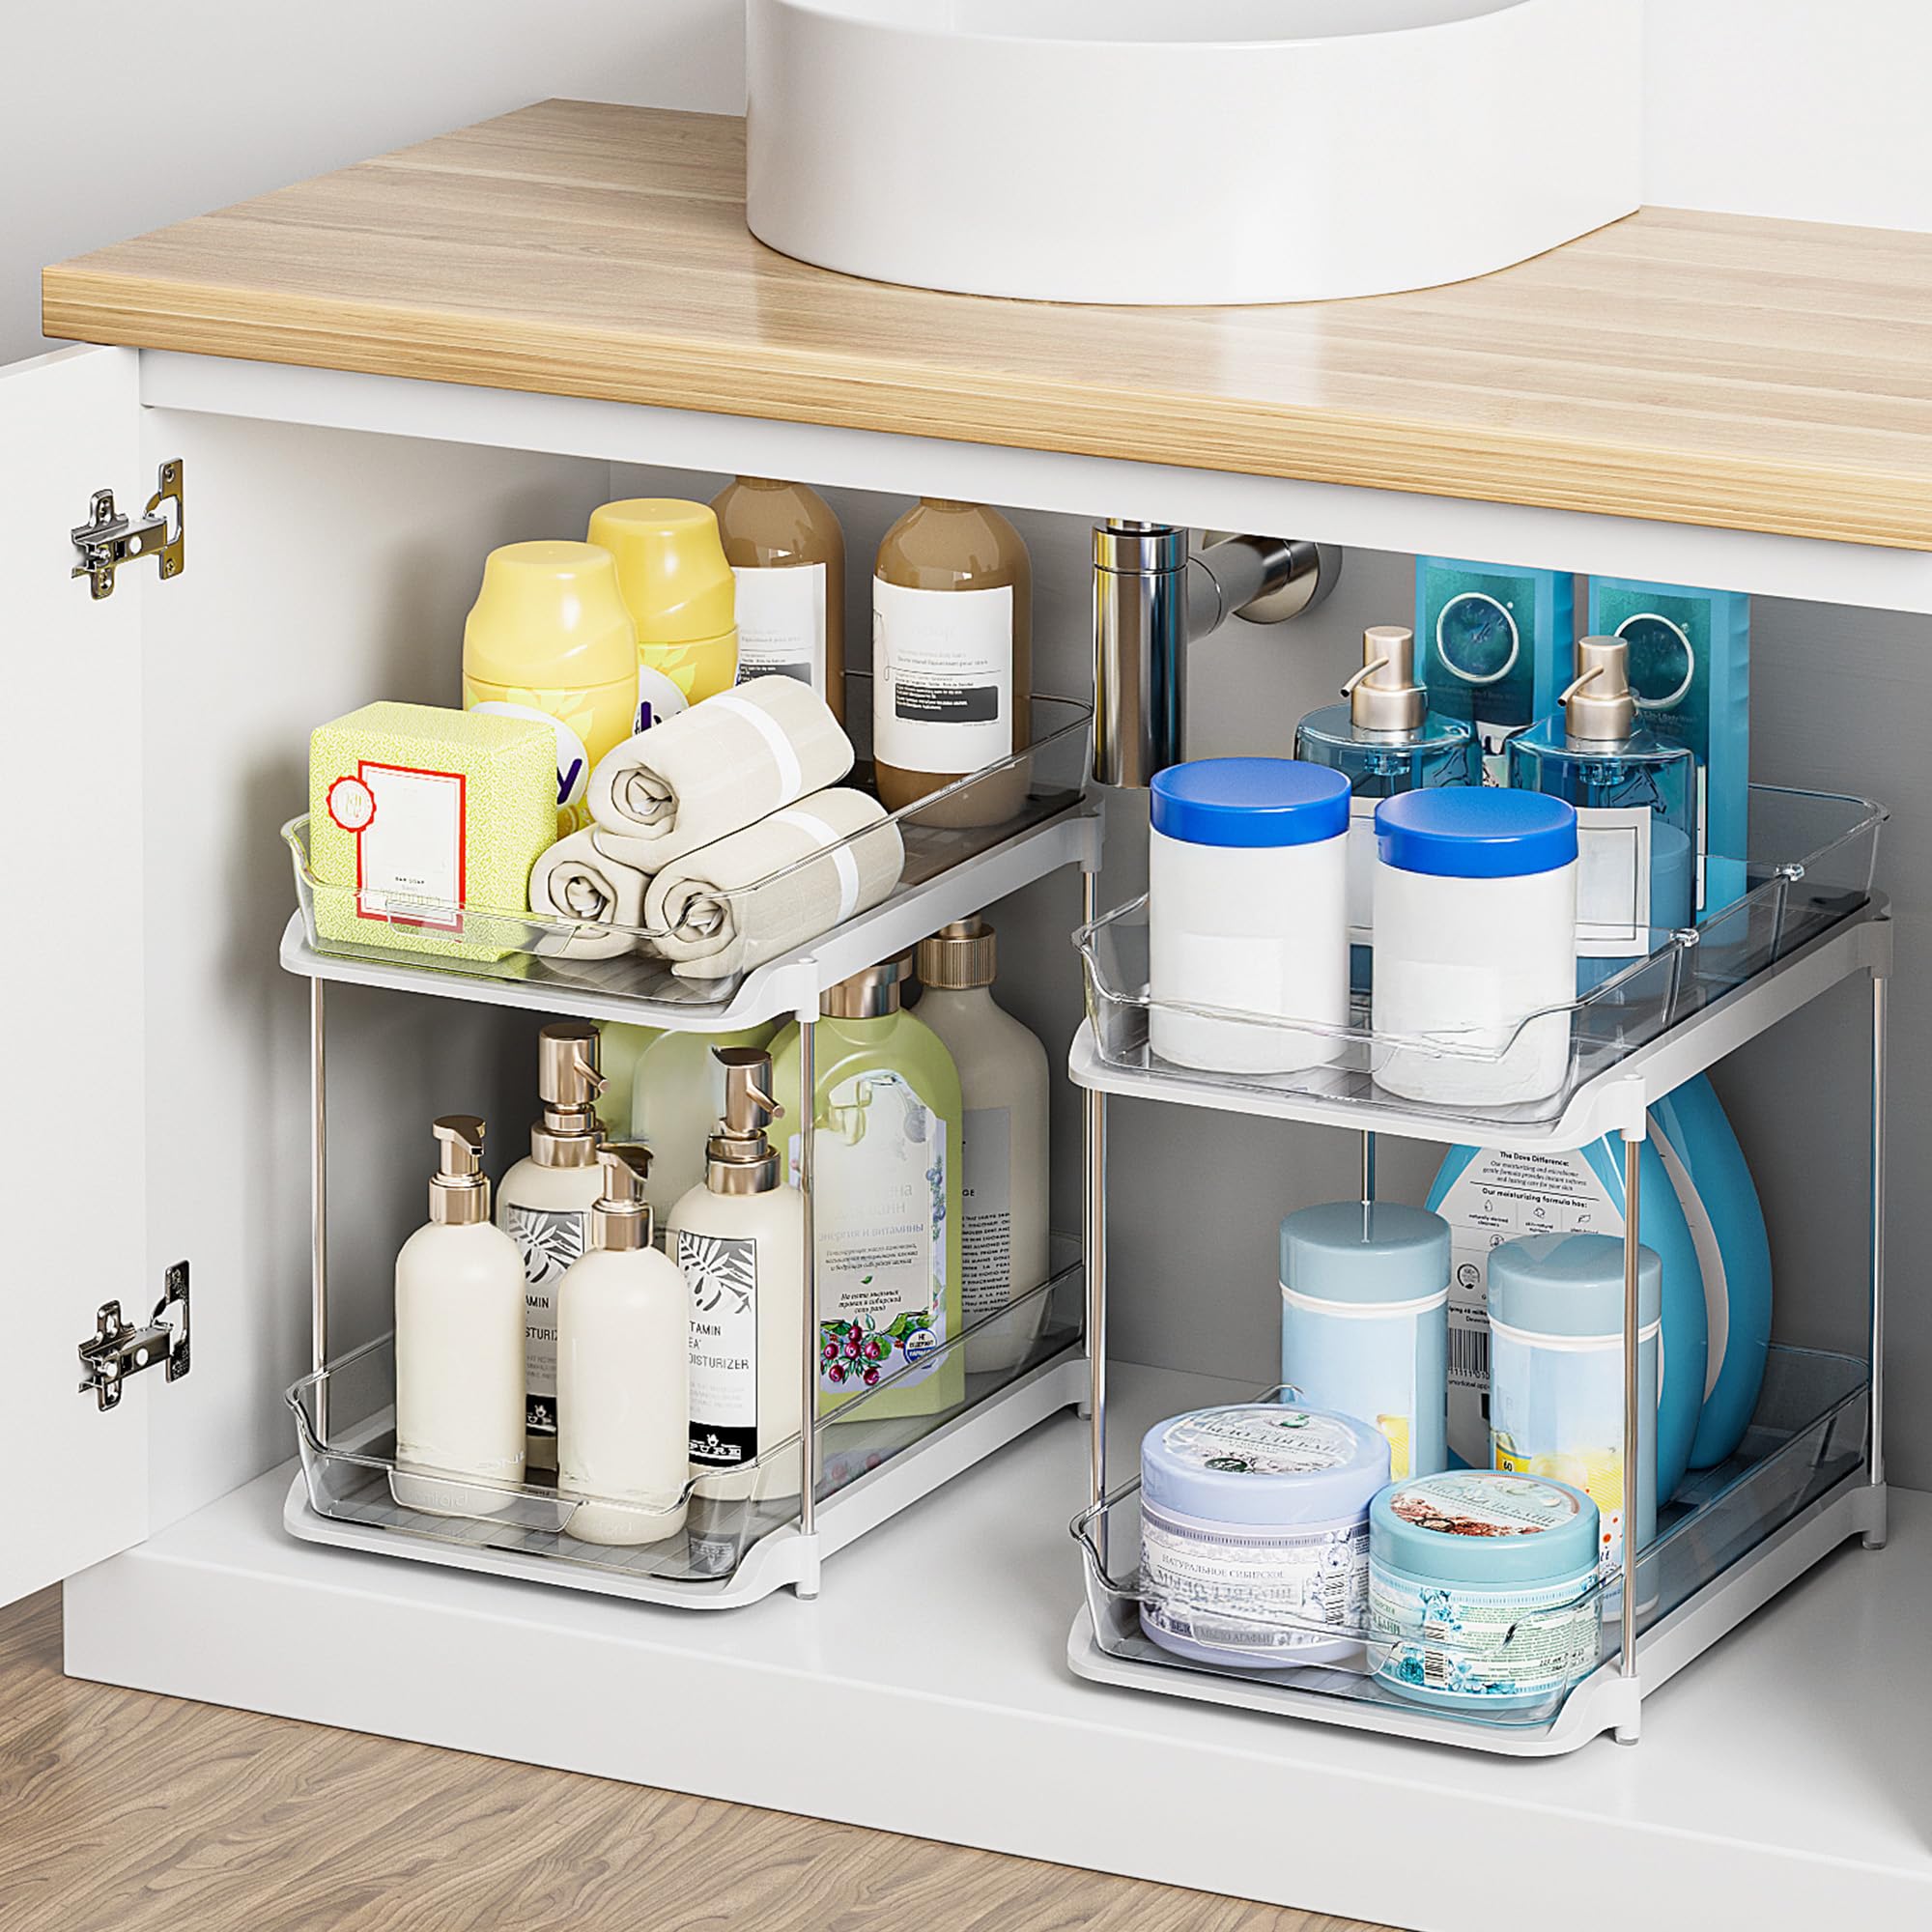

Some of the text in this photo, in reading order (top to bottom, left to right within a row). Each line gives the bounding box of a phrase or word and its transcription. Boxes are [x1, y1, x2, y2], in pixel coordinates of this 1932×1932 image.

[1500, 1151, 1512, 1159] The
[1514, 1152, 1530, 1162] Dove
[1542, 1195, 1571, 1206] formula
[526, 1294, 549, 1309] AMIN
[690, 1321, 722, 1336] TAMIN
[689, 1352, 750, 1371] OISTURIZER
